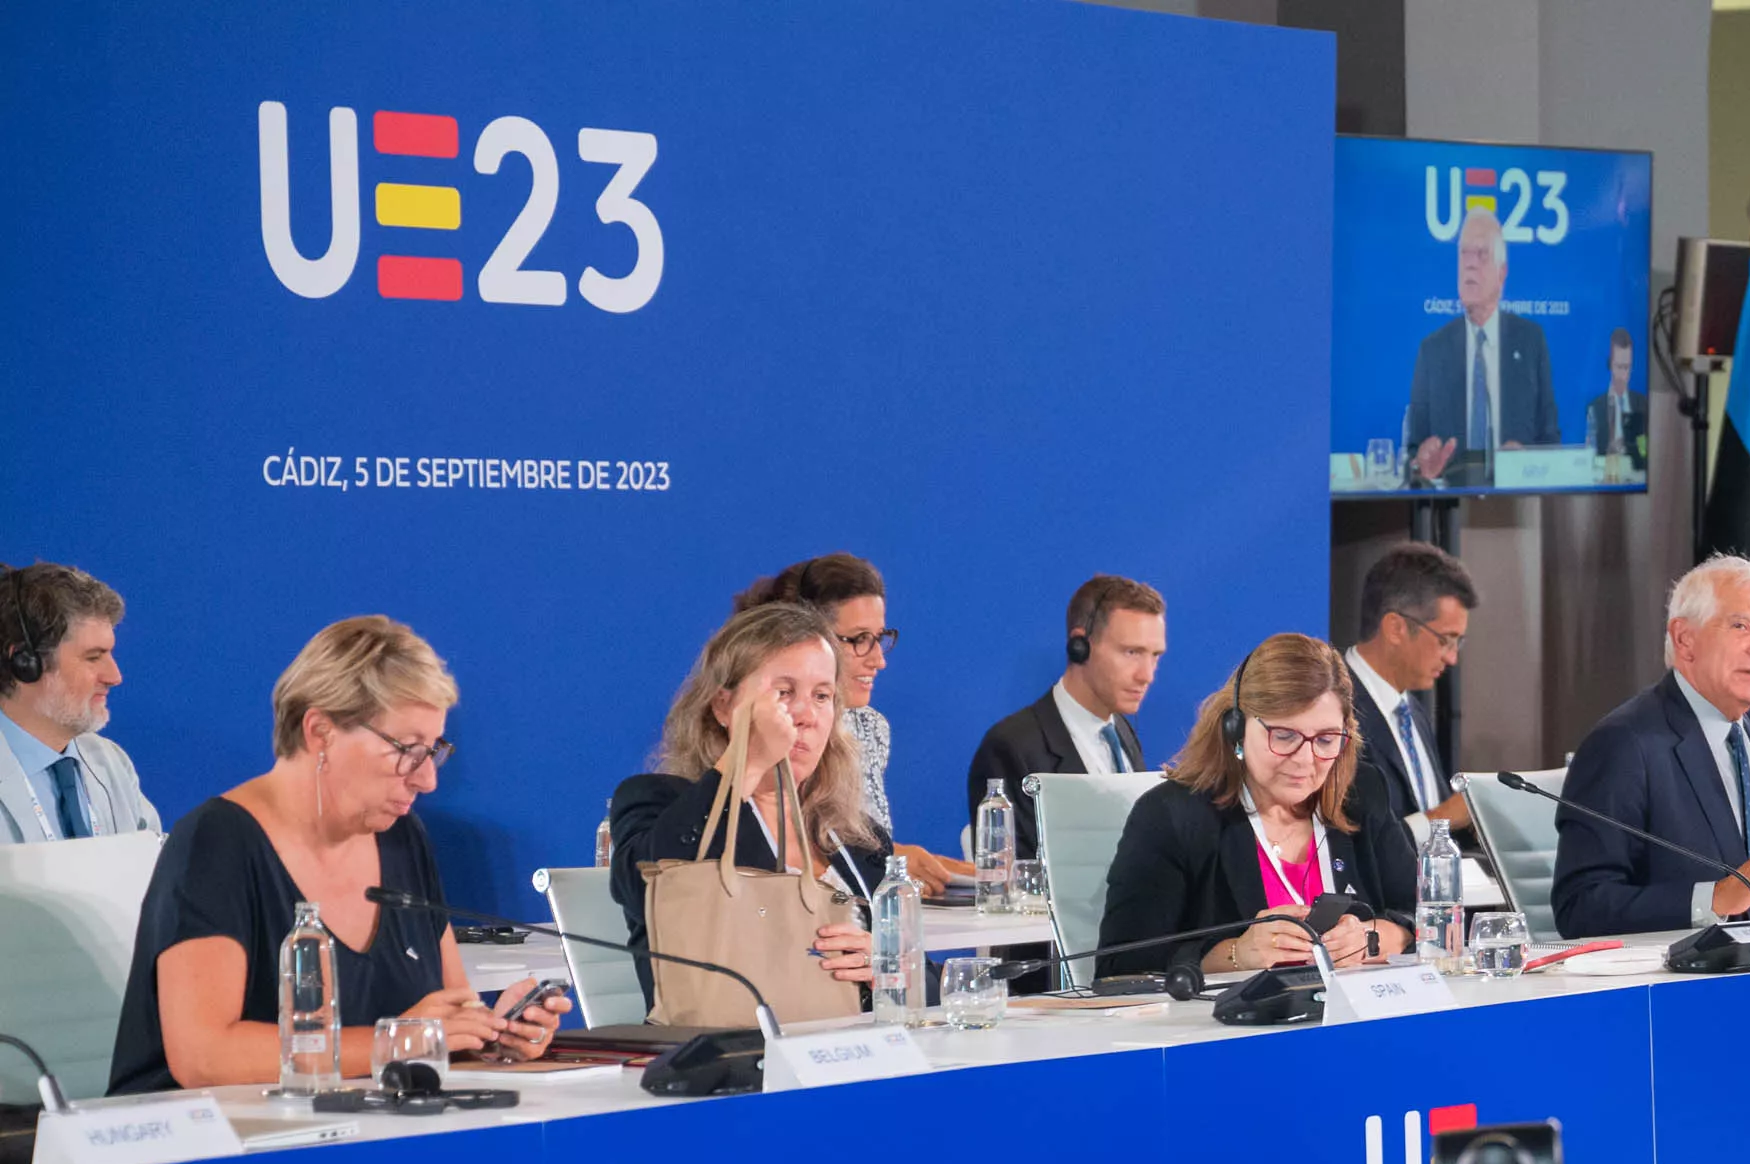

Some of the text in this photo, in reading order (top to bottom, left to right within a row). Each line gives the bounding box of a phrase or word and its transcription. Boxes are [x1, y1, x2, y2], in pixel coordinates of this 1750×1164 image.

[258, 100, 664, 313] UE23
[262, 447, 670, 491] CÁDIZ, 5 DE SEPTIEMBRE DE 2023
[1370, 982, 1406, 998] SPAIN
[808, 1044, 874, 1063] BELGIUM
[86, 1119, 173, 1146] HUNGARY
